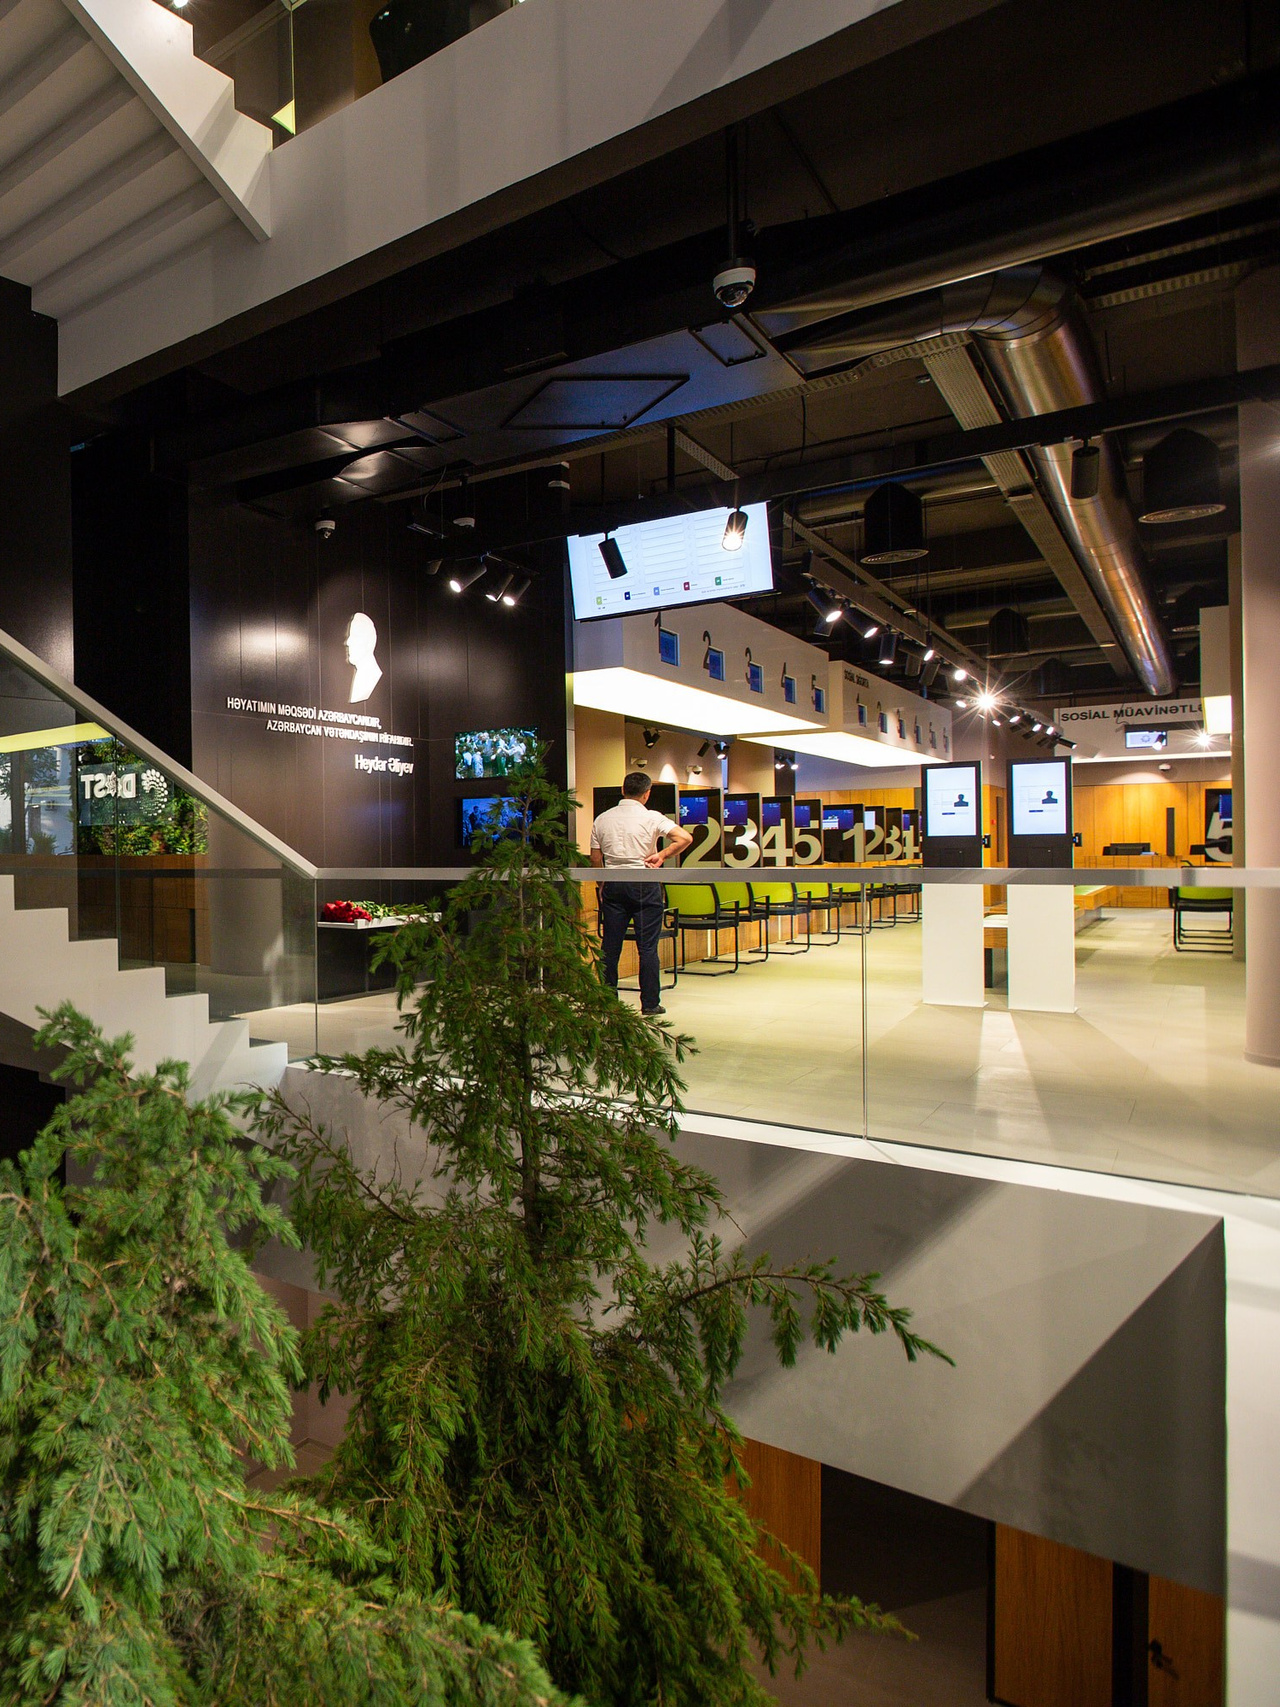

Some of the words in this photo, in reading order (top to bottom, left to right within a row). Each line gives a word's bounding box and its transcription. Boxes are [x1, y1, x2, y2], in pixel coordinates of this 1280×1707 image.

[226, 696, 277, 715] HƏYATIMIN
[277, 703, 318, 720] MƏQSƏDİ
[266, 719, 322, 737] AZƏRBAYCAN
[1061, 708, 1110, 722] SOSİAL
[681, 817, 721, 868] 2
[724, 818, 761, 868] 3
[763, 818, 794, 867] 4
[794, 820, 822, 866] 5
[842, 823, 865, 863] 1
[865, 824, 885, 862] 2
